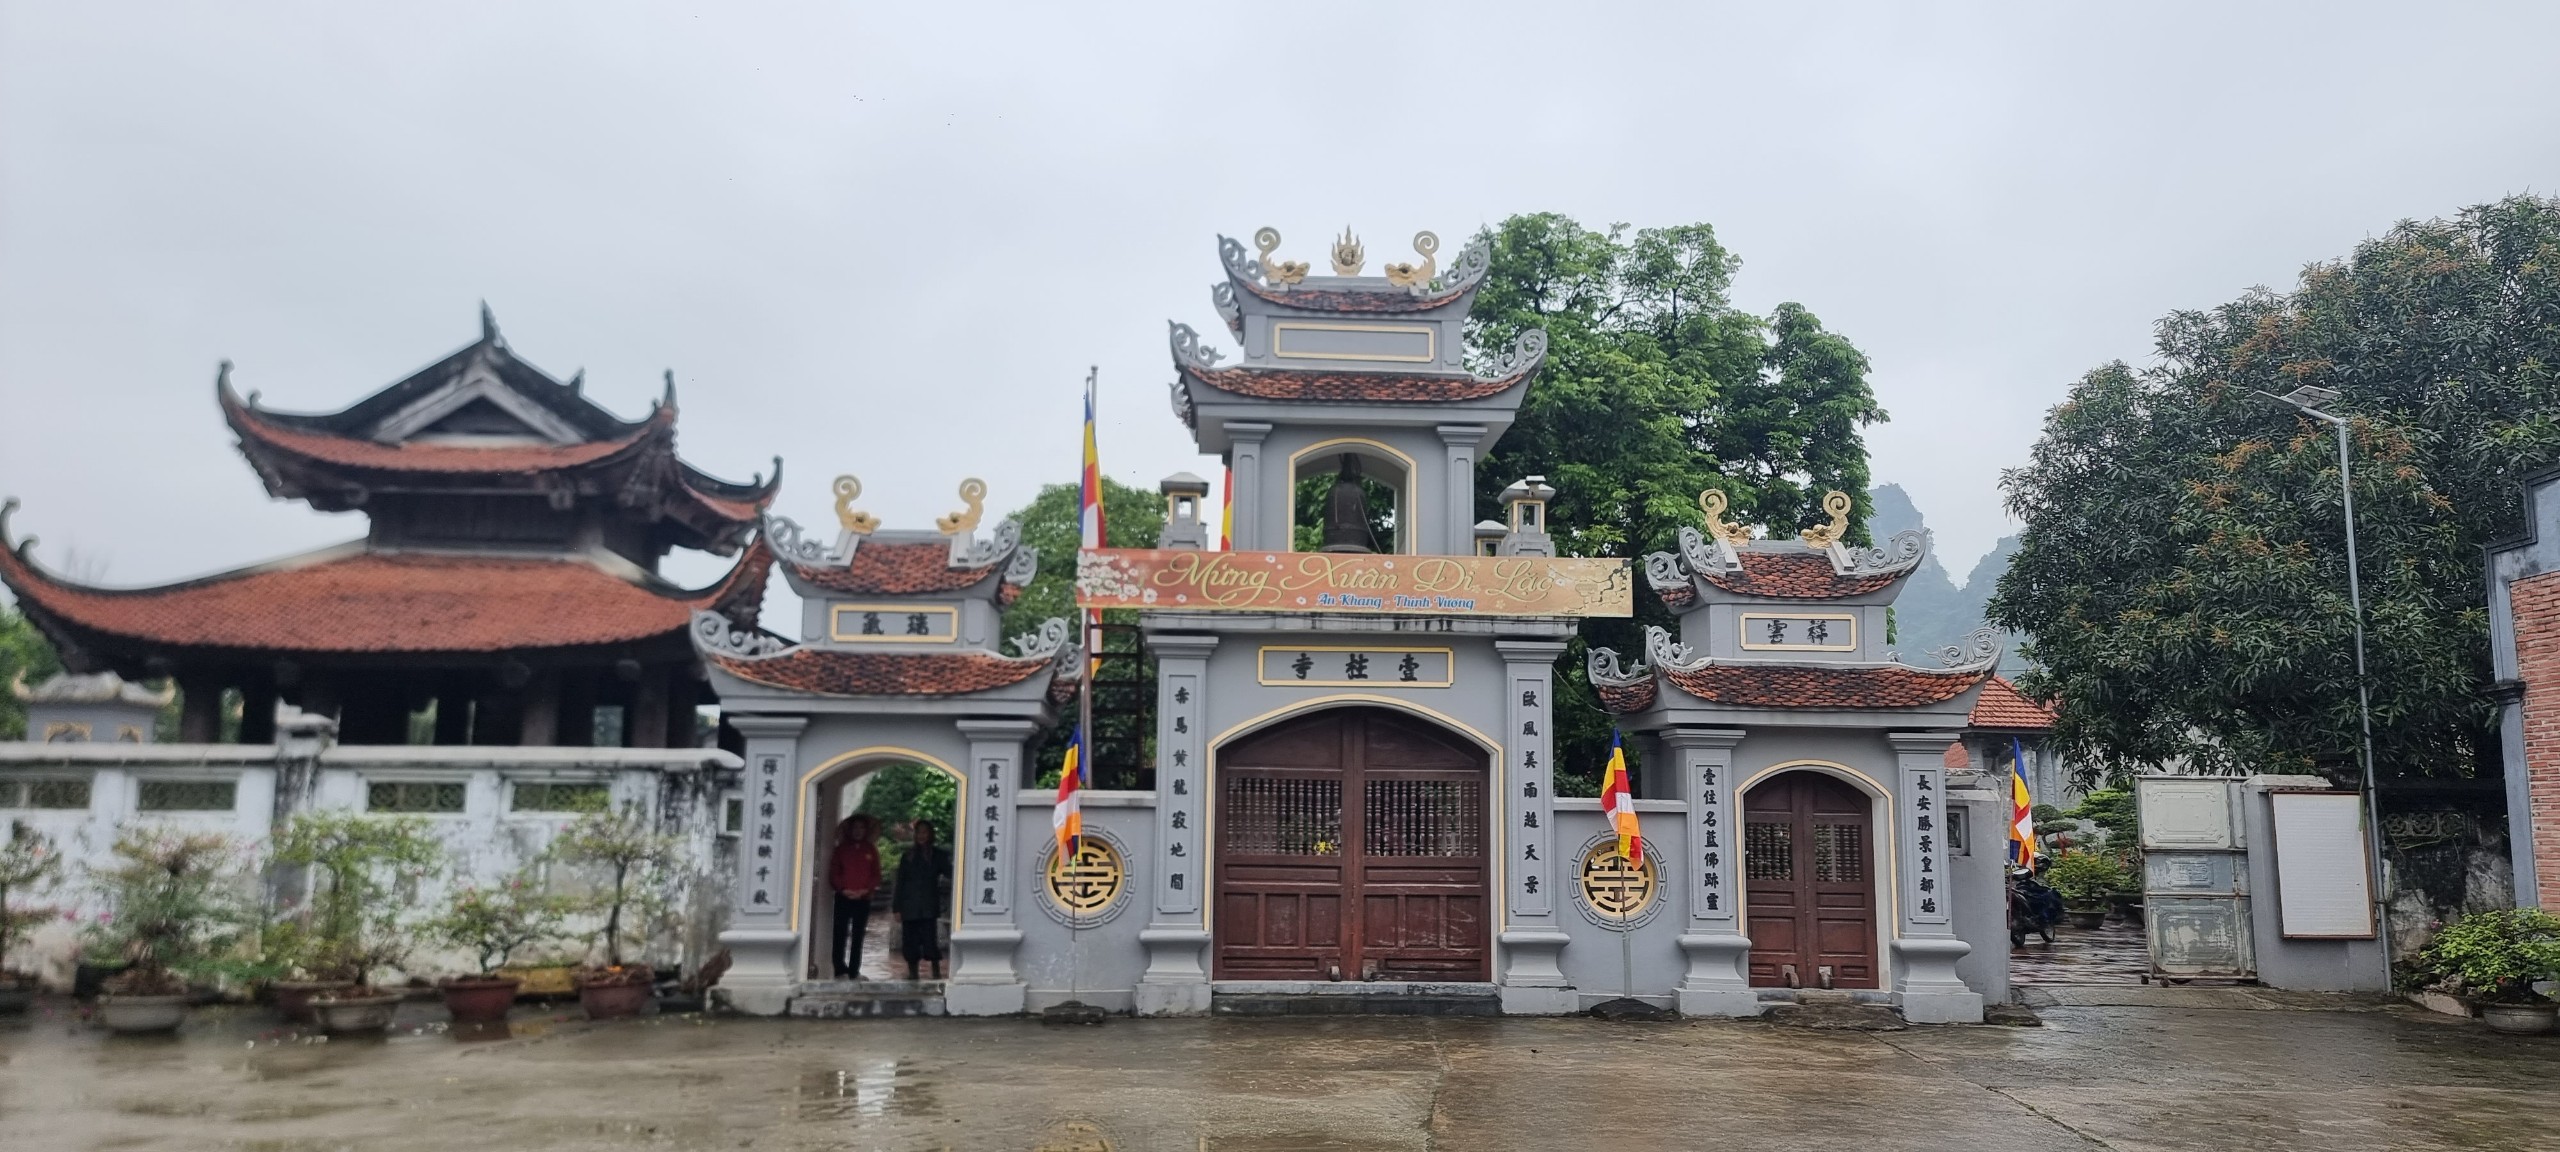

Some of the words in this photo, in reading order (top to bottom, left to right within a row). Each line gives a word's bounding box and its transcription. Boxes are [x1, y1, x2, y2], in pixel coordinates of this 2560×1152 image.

[1153, 552, 1282, 608] Mừng
[1279, 555, 1400, 591] Xuân
[1412, 558, 1475, 592] Di
[1318, 592, 1338, 606] An
[1340, 593, 1383, 609] Khang
